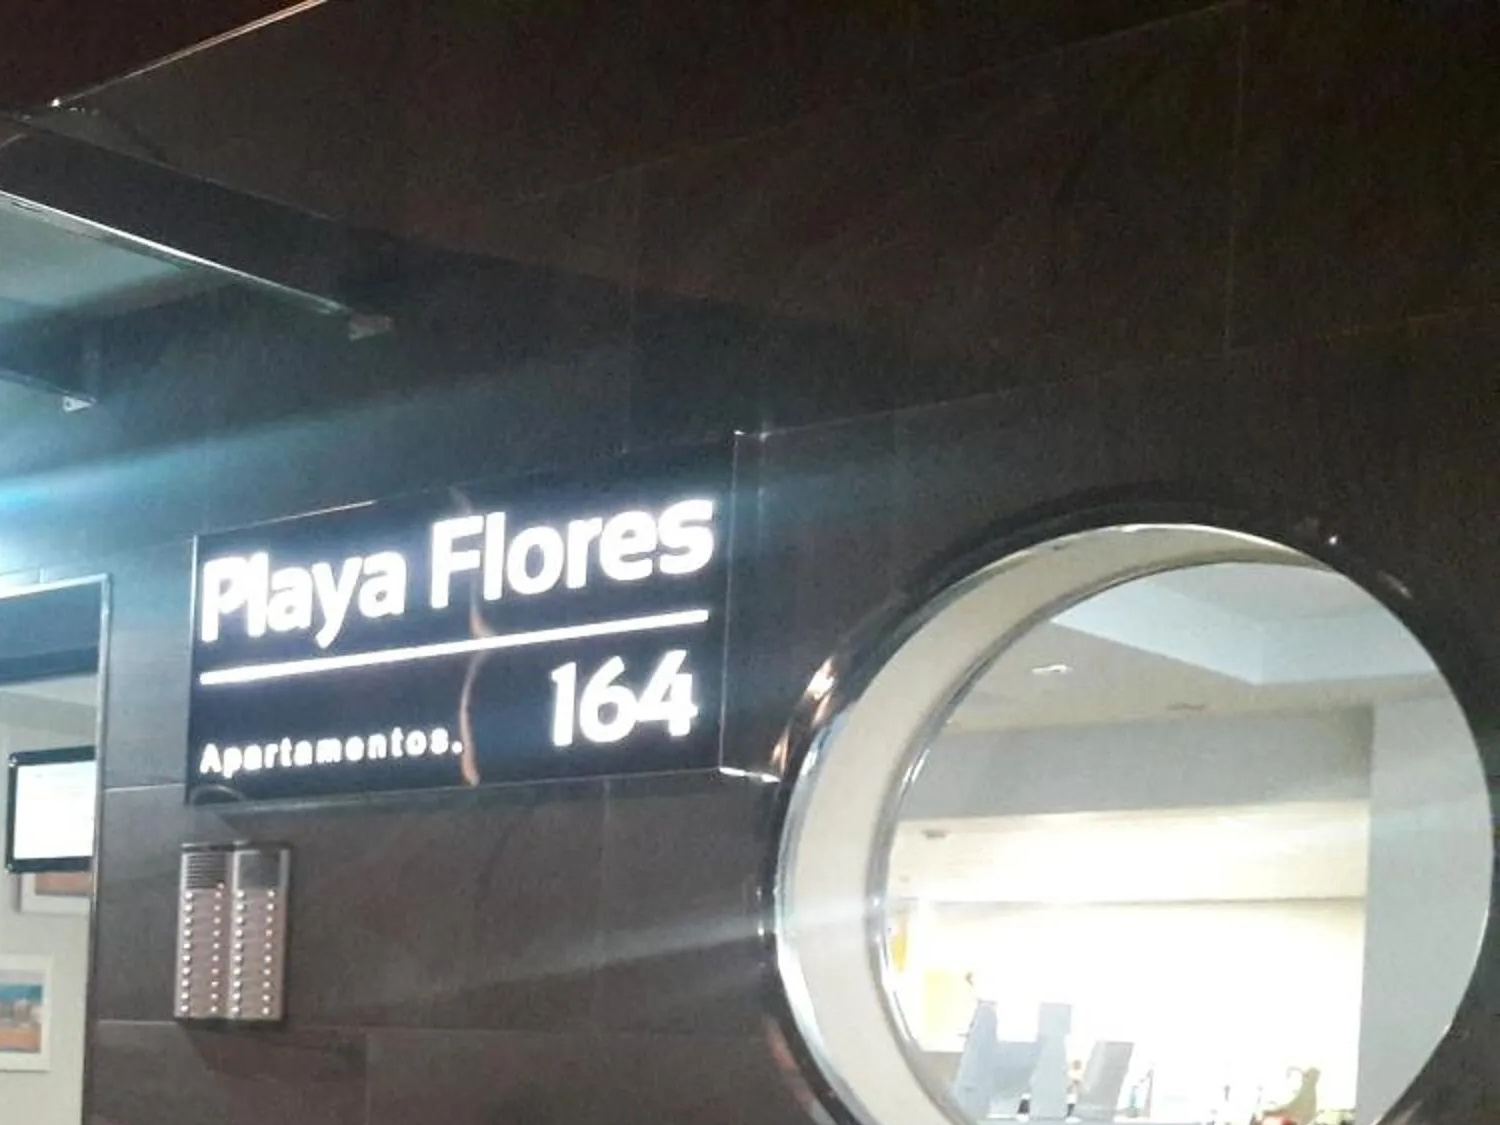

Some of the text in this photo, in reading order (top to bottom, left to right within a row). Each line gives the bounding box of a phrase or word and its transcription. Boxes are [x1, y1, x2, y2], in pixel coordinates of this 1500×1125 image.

[201, 499, 715, 648] Playa Flores
[551, 649, 699, 747] 164
